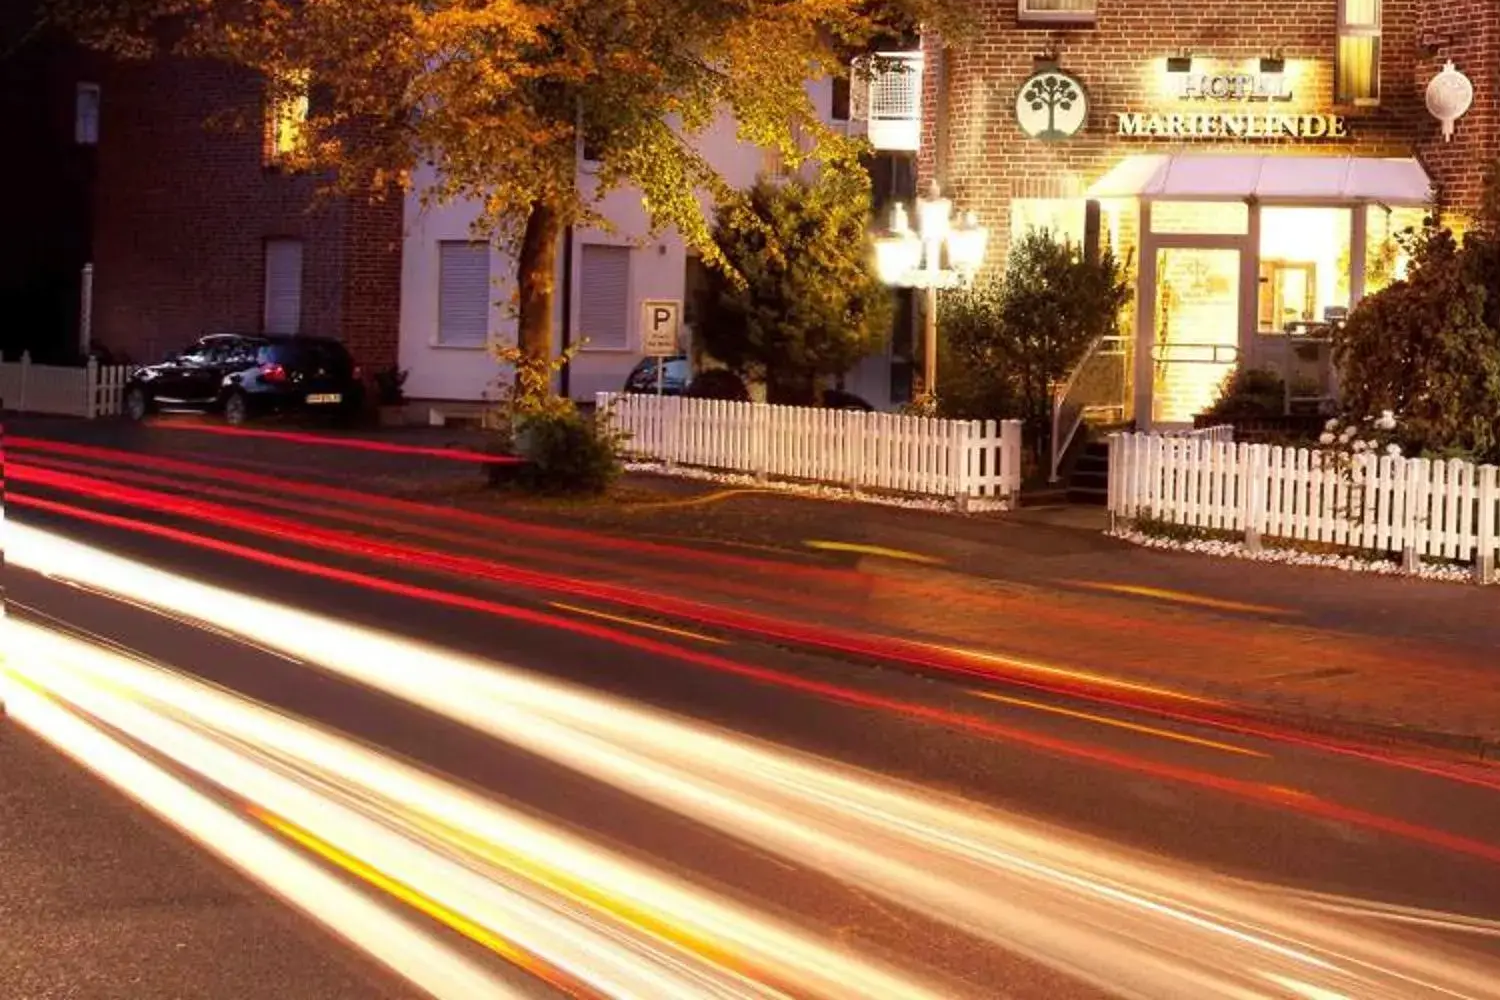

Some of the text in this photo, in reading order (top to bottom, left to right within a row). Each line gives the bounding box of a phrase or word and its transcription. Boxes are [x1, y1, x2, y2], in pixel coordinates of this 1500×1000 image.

[1179, 73, 1293, 102] HOTEL
[1117, 111, 1348, 138] MARIENLINDE
[653, 307, 671, 331] P
